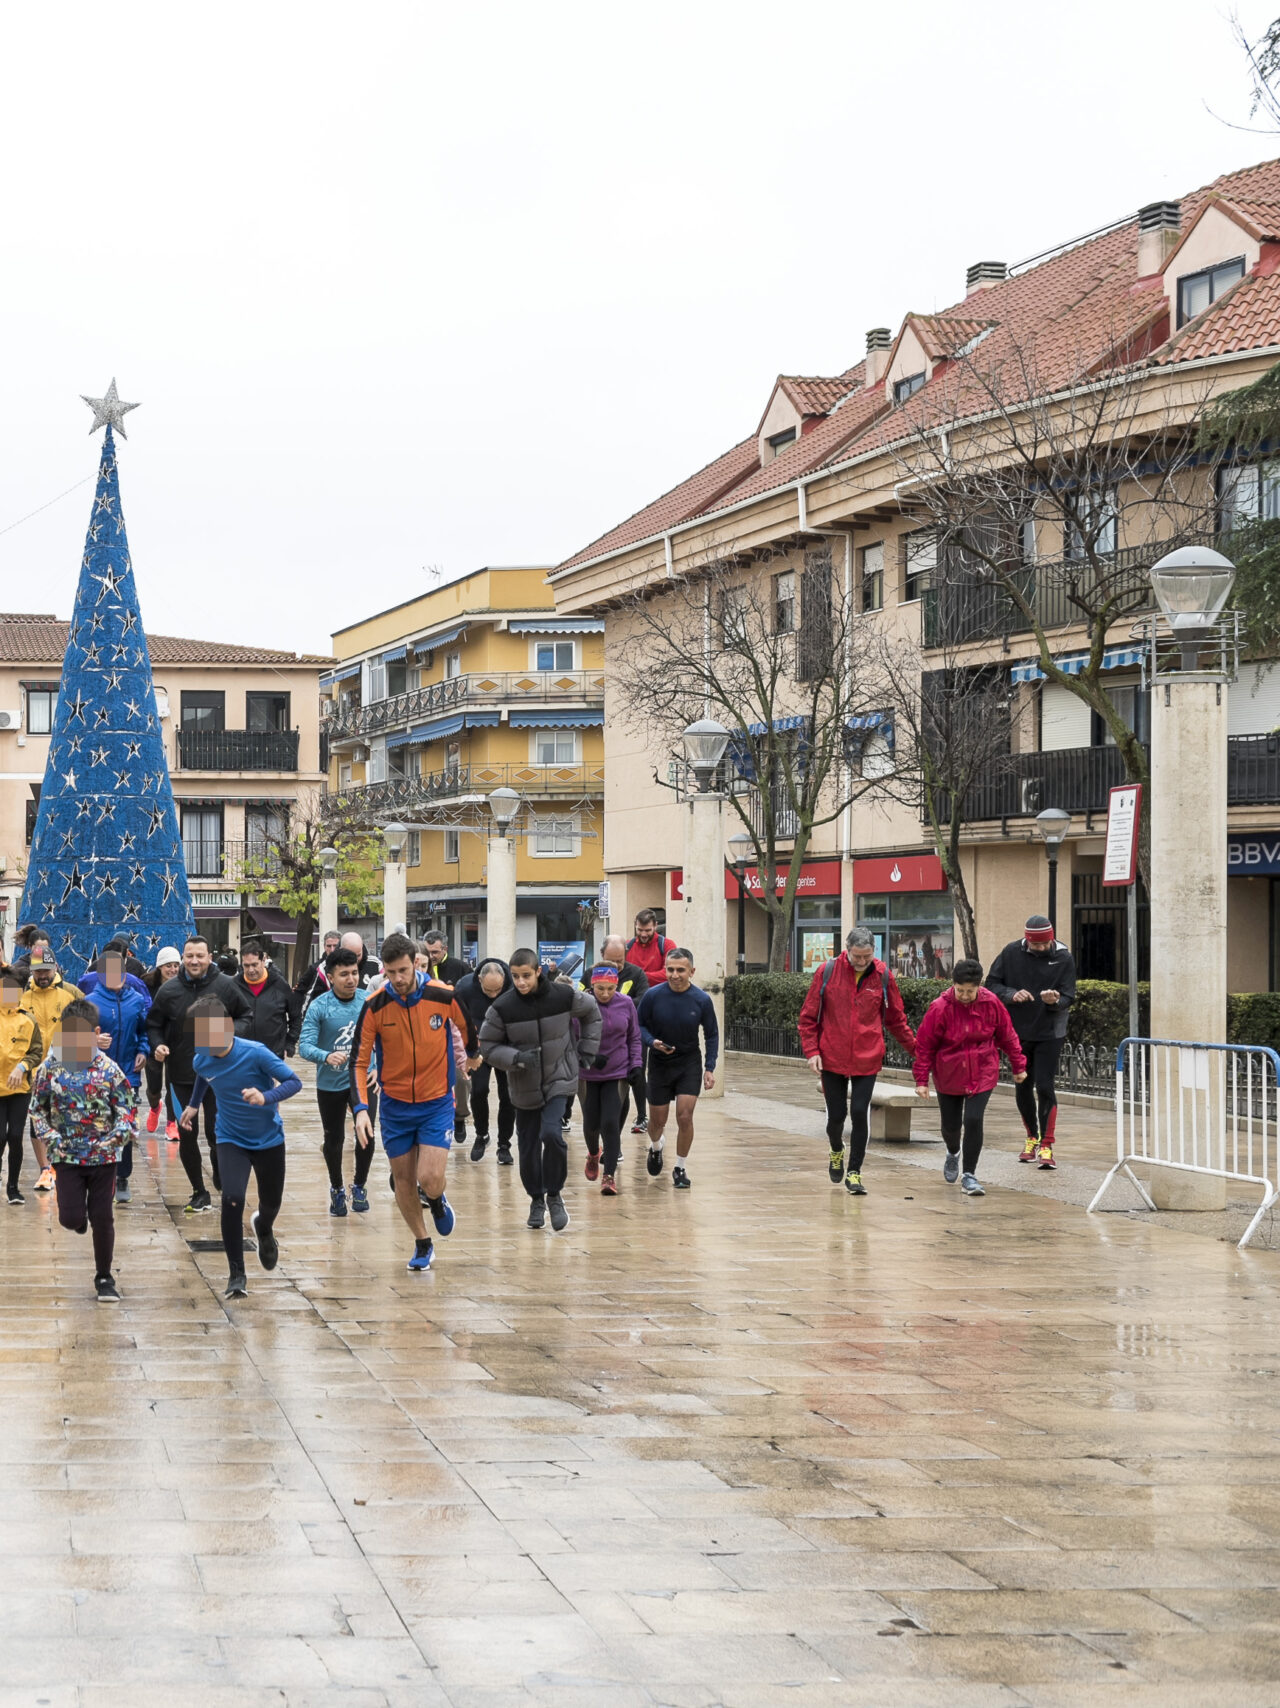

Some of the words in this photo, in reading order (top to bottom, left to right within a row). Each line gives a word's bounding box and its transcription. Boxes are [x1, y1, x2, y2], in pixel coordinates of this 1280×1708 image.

[1228, 843, 1280, 864] BBV
[796, 876, 816, 889] gentes
[195, 893, 223, 905] VELILLA
[224, 893, 238, 905] S.L.
